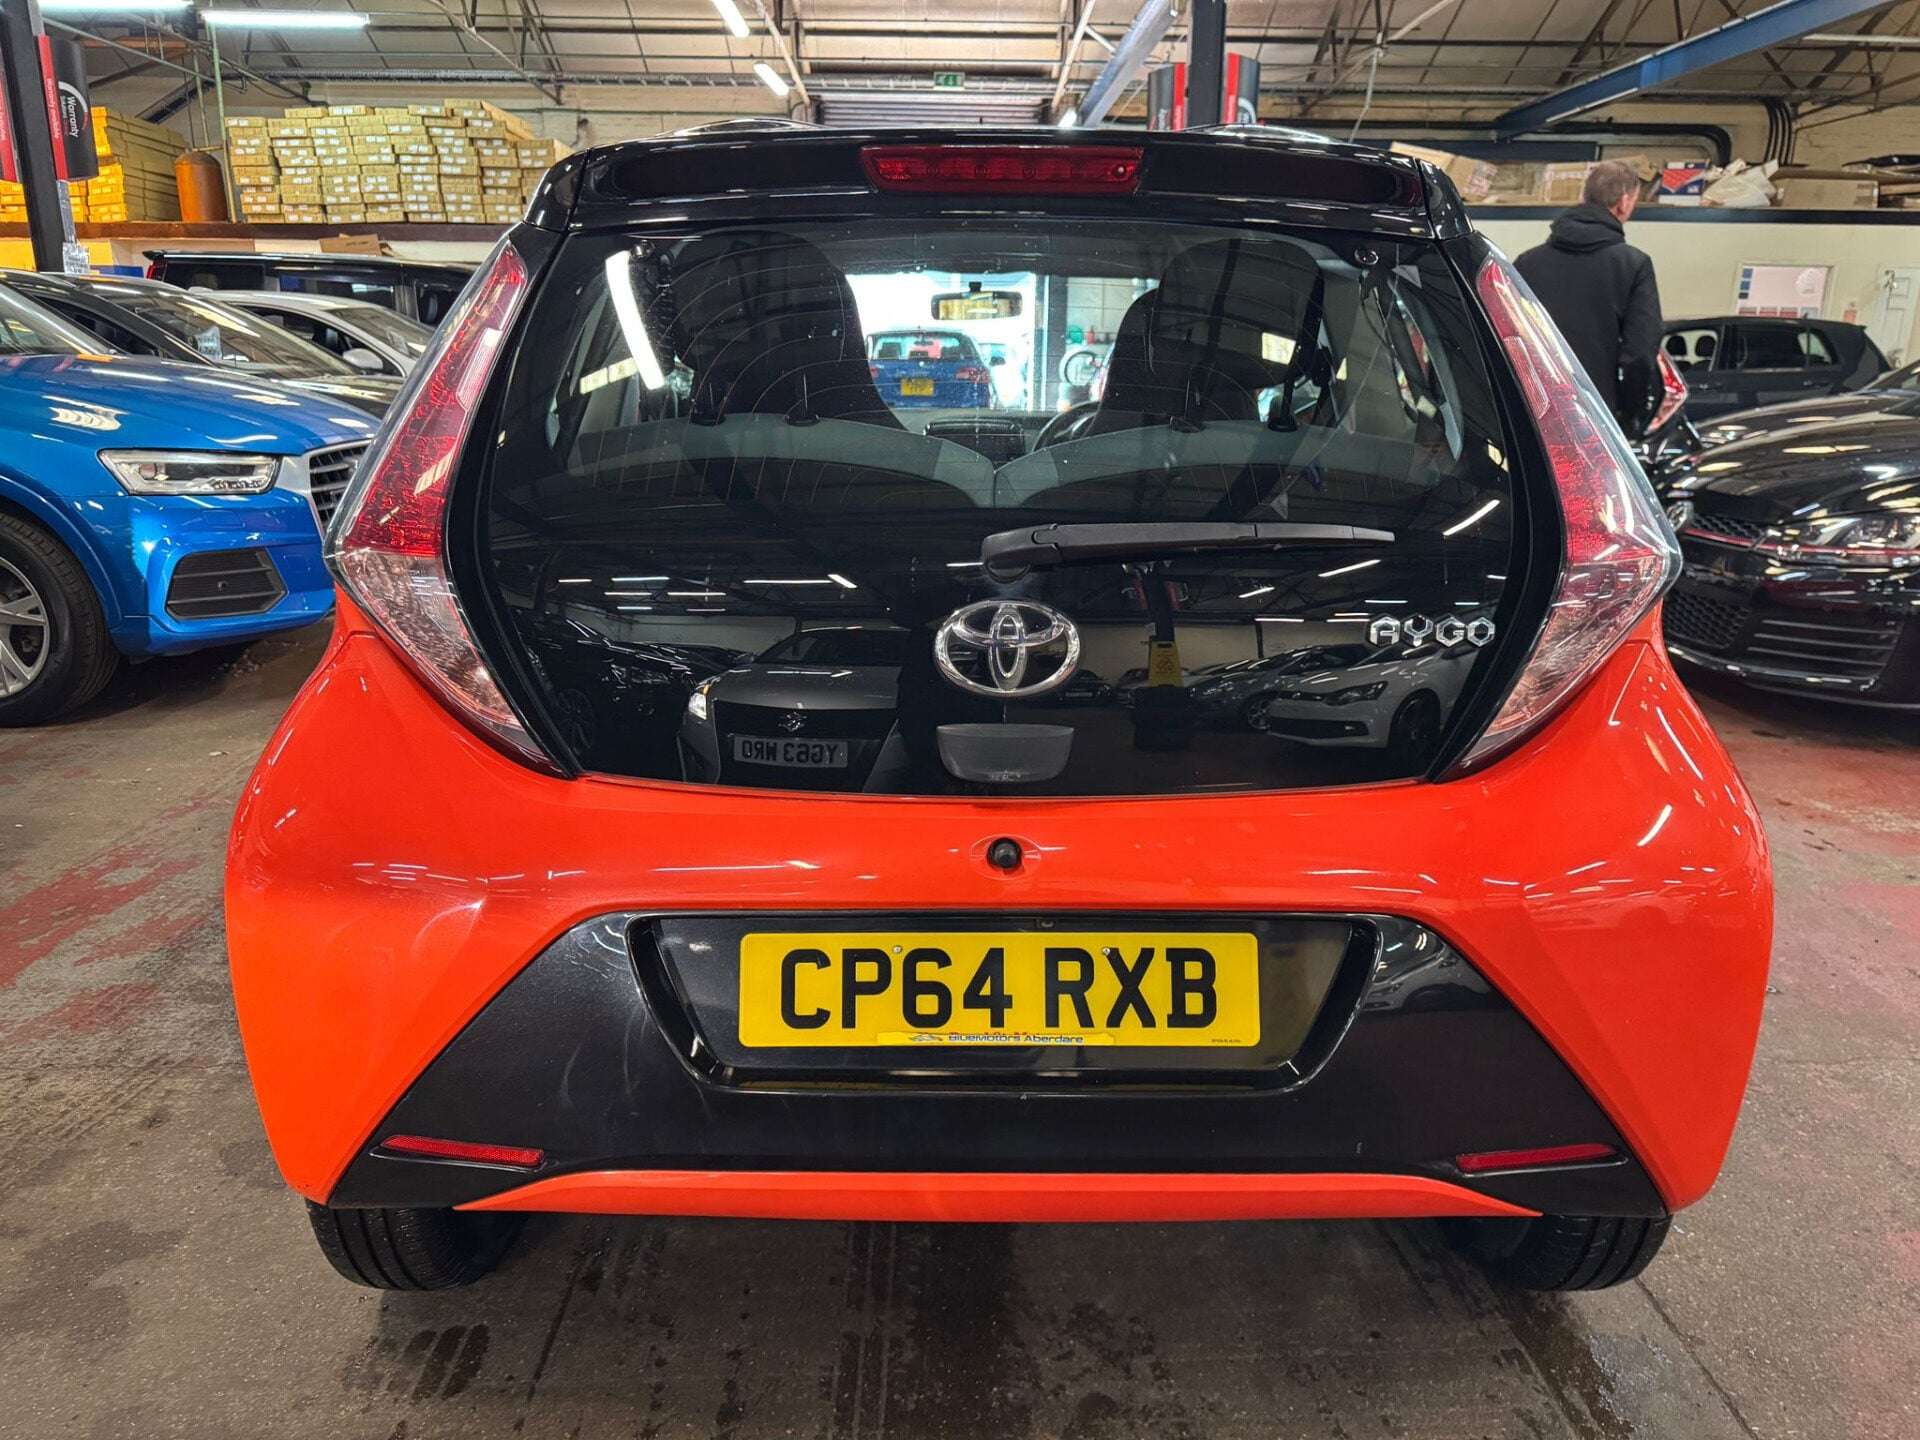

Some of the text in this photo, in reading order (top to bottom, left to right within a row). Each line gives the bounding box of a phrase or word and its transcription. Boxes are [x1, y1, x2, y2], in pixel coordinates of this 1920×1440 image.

[67, 96, 79, 138] Warranty
[1369, 616, 1496, 648] AYGO
[781, 947, 1217, 1030] CP64 RXB
[1024, 1034, 1084, 1044] Aberdare
